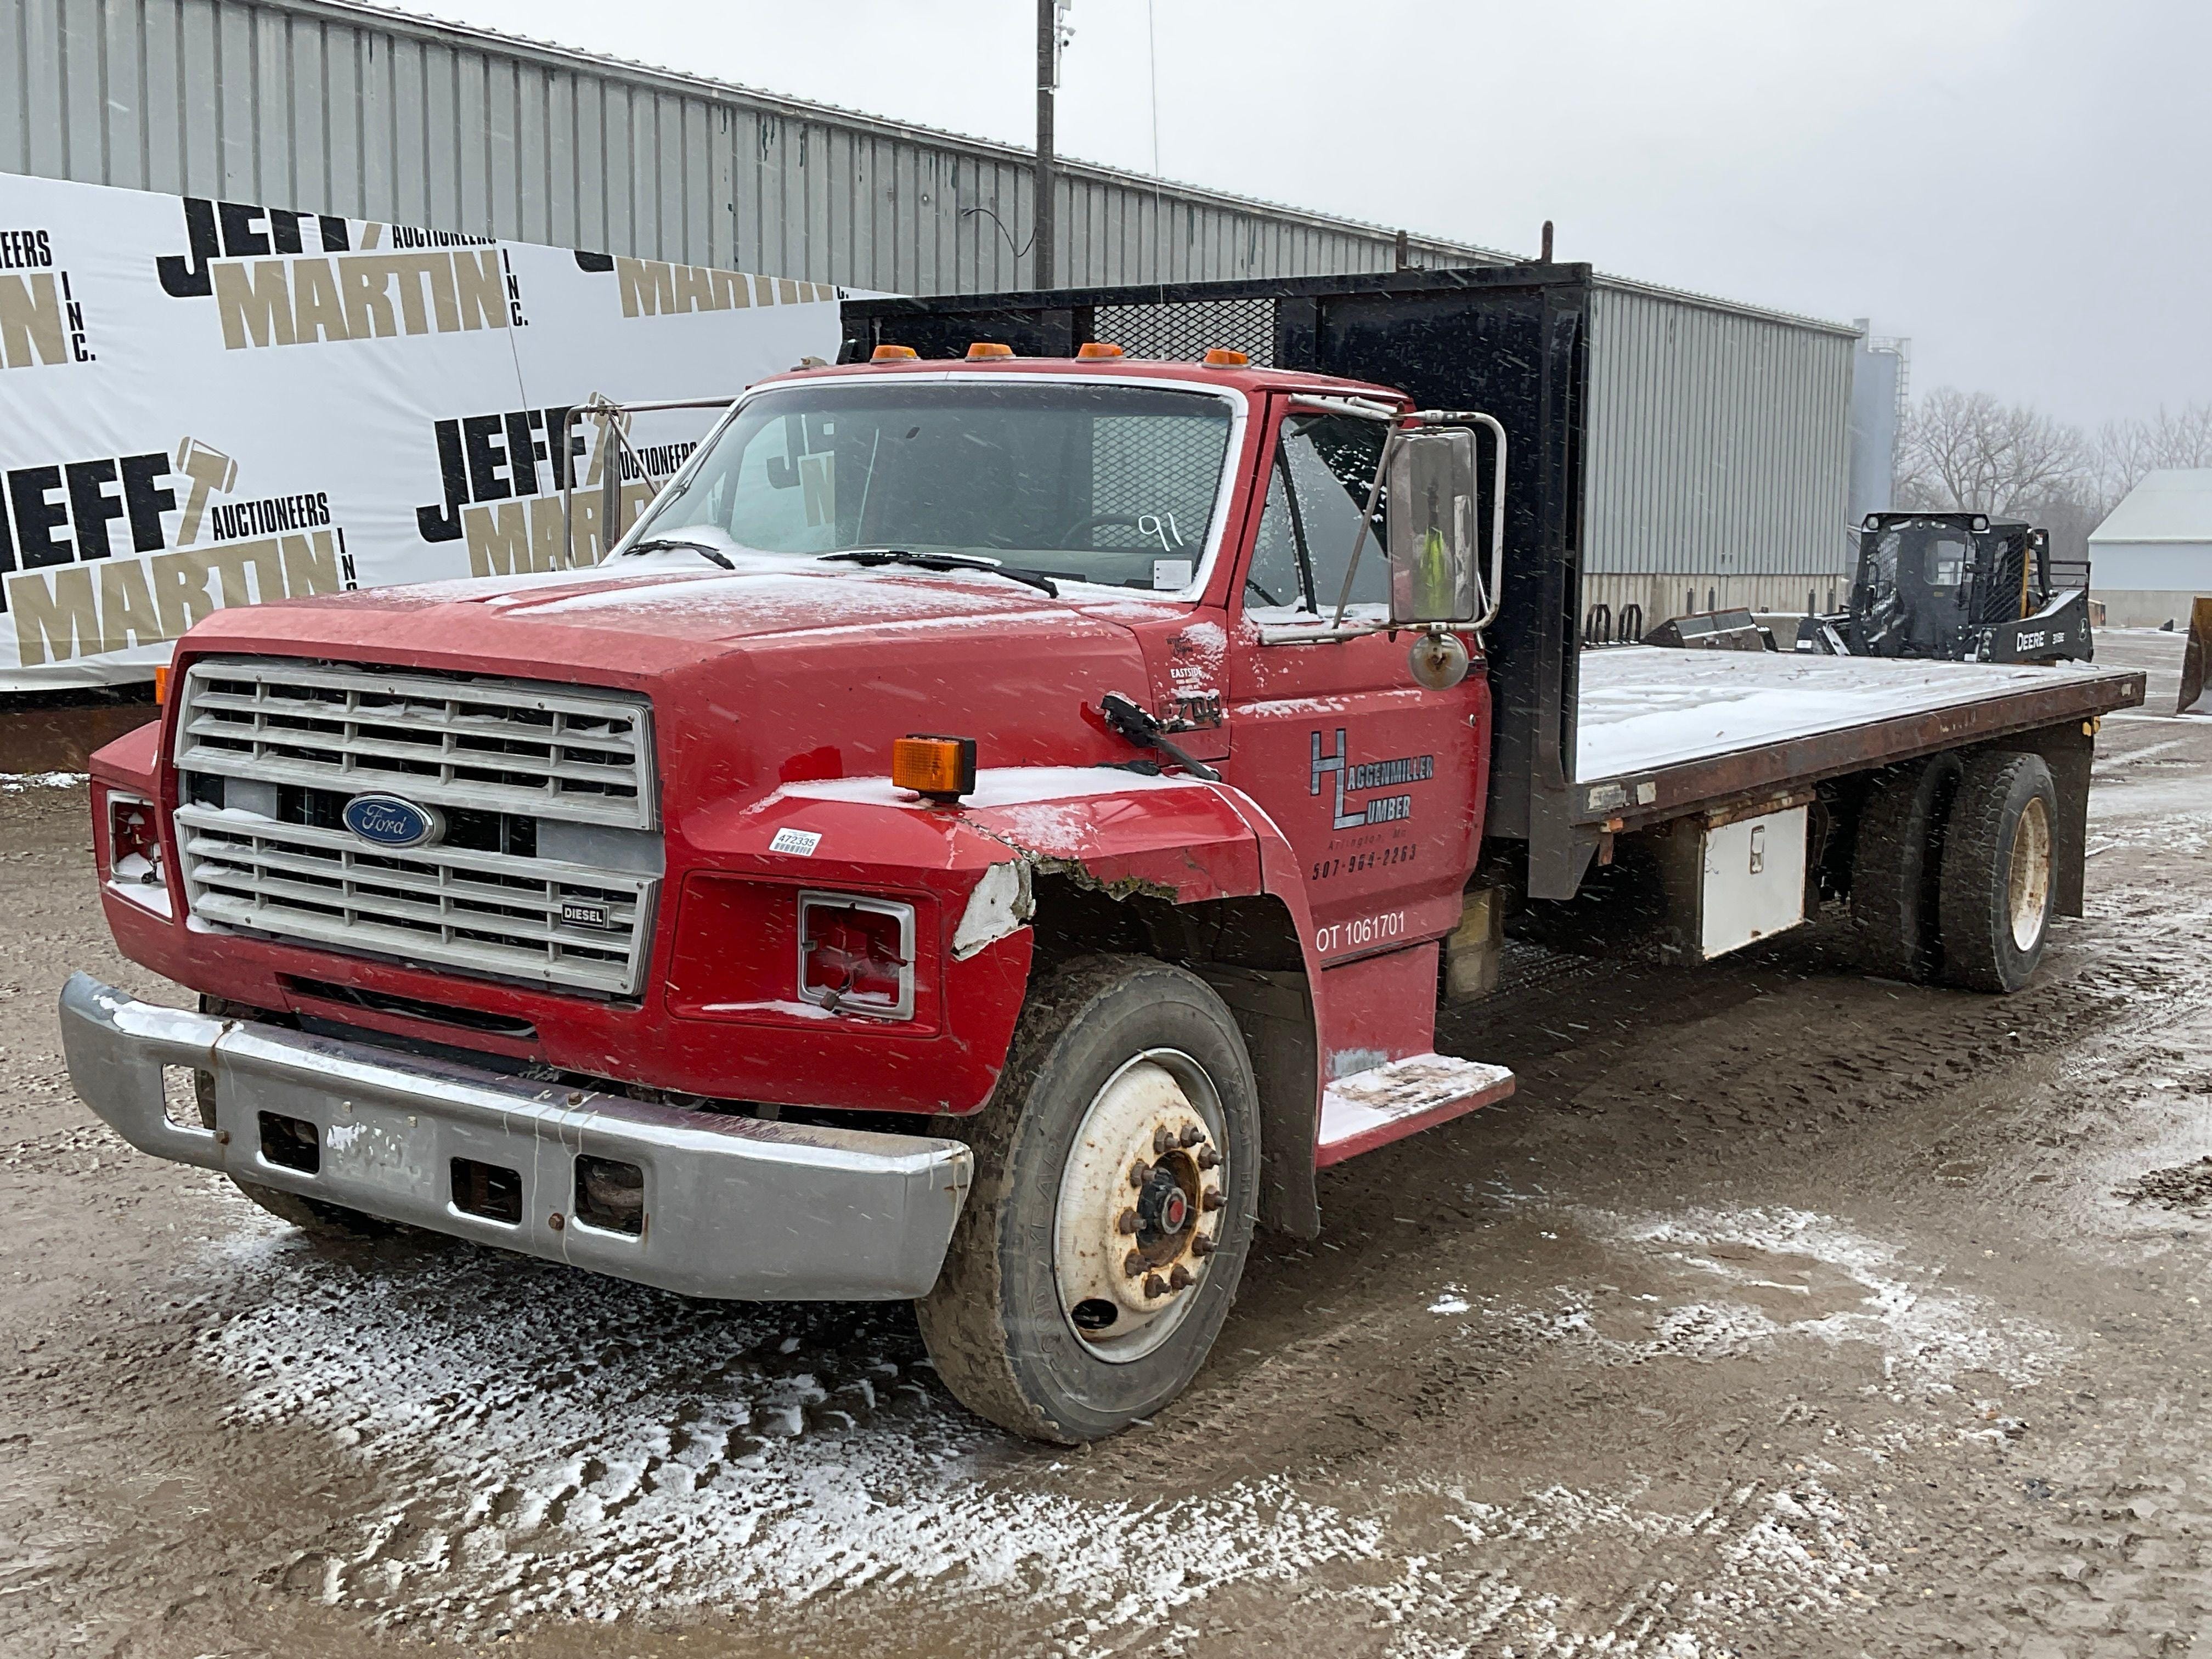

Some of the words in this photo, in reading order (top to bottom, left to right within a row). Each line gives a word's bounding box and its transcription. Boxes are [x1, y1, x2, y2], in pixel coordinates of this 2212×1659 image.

[0, 230, 52, 268] EERS
[213, 250, 508, 350] MARTIN
[503, 249, 528, 326] INC.
[61, 271, 96, 362] INC.
[416, 405, 586, 543] JEFF
[211, 492, 330, 541] AUCTIONEERS
[1138, 512, 1184, 552] 91
[8, 530, 339, 668] MARTIN
[2016, 631, 2045, 652] DEERE
[1170, 667, 1203, 679] EASTSIDE
[362, 804, 407, 835] Ford
[778, 834, 816, 847] 472335
[565, 907, 602, 922] DIESEL
[1345, 911, 1405, 946] 1061701
